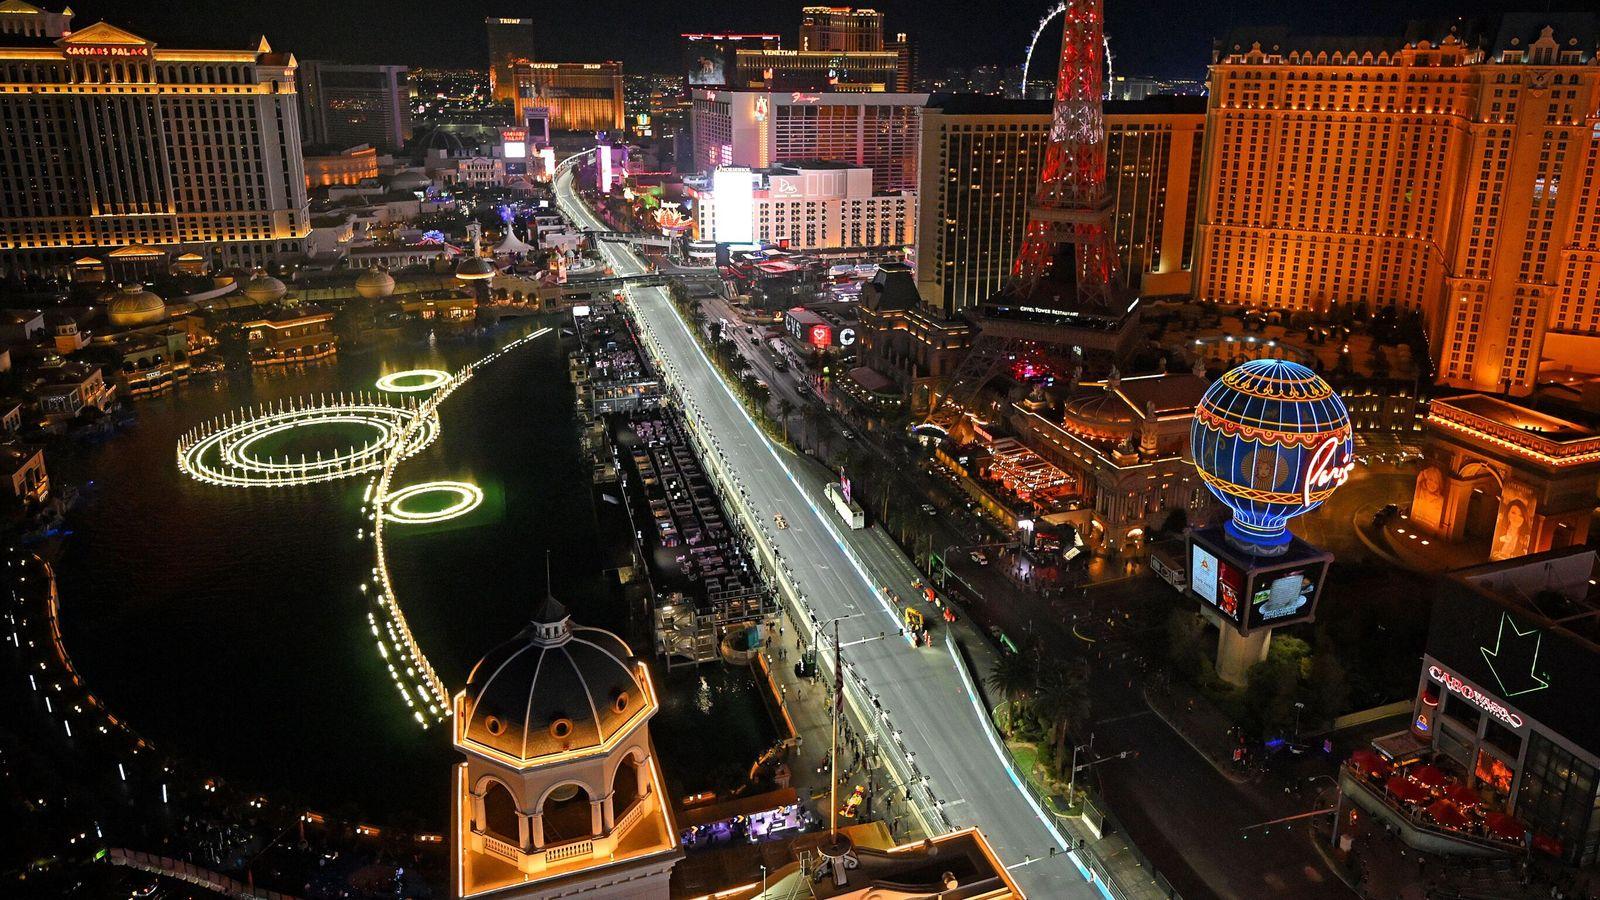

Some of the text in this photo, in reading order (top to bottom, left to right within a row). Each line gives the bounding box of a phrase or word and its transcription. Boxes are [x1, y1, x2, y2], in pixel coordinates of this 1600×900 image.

[66, 46, 148, 56] CAESARS PALACE
[785, 314, 801, 339] CVS
[1304, 436, 1355, 507] Paris
[1428, 665, 1511, 721] CABO WABO
